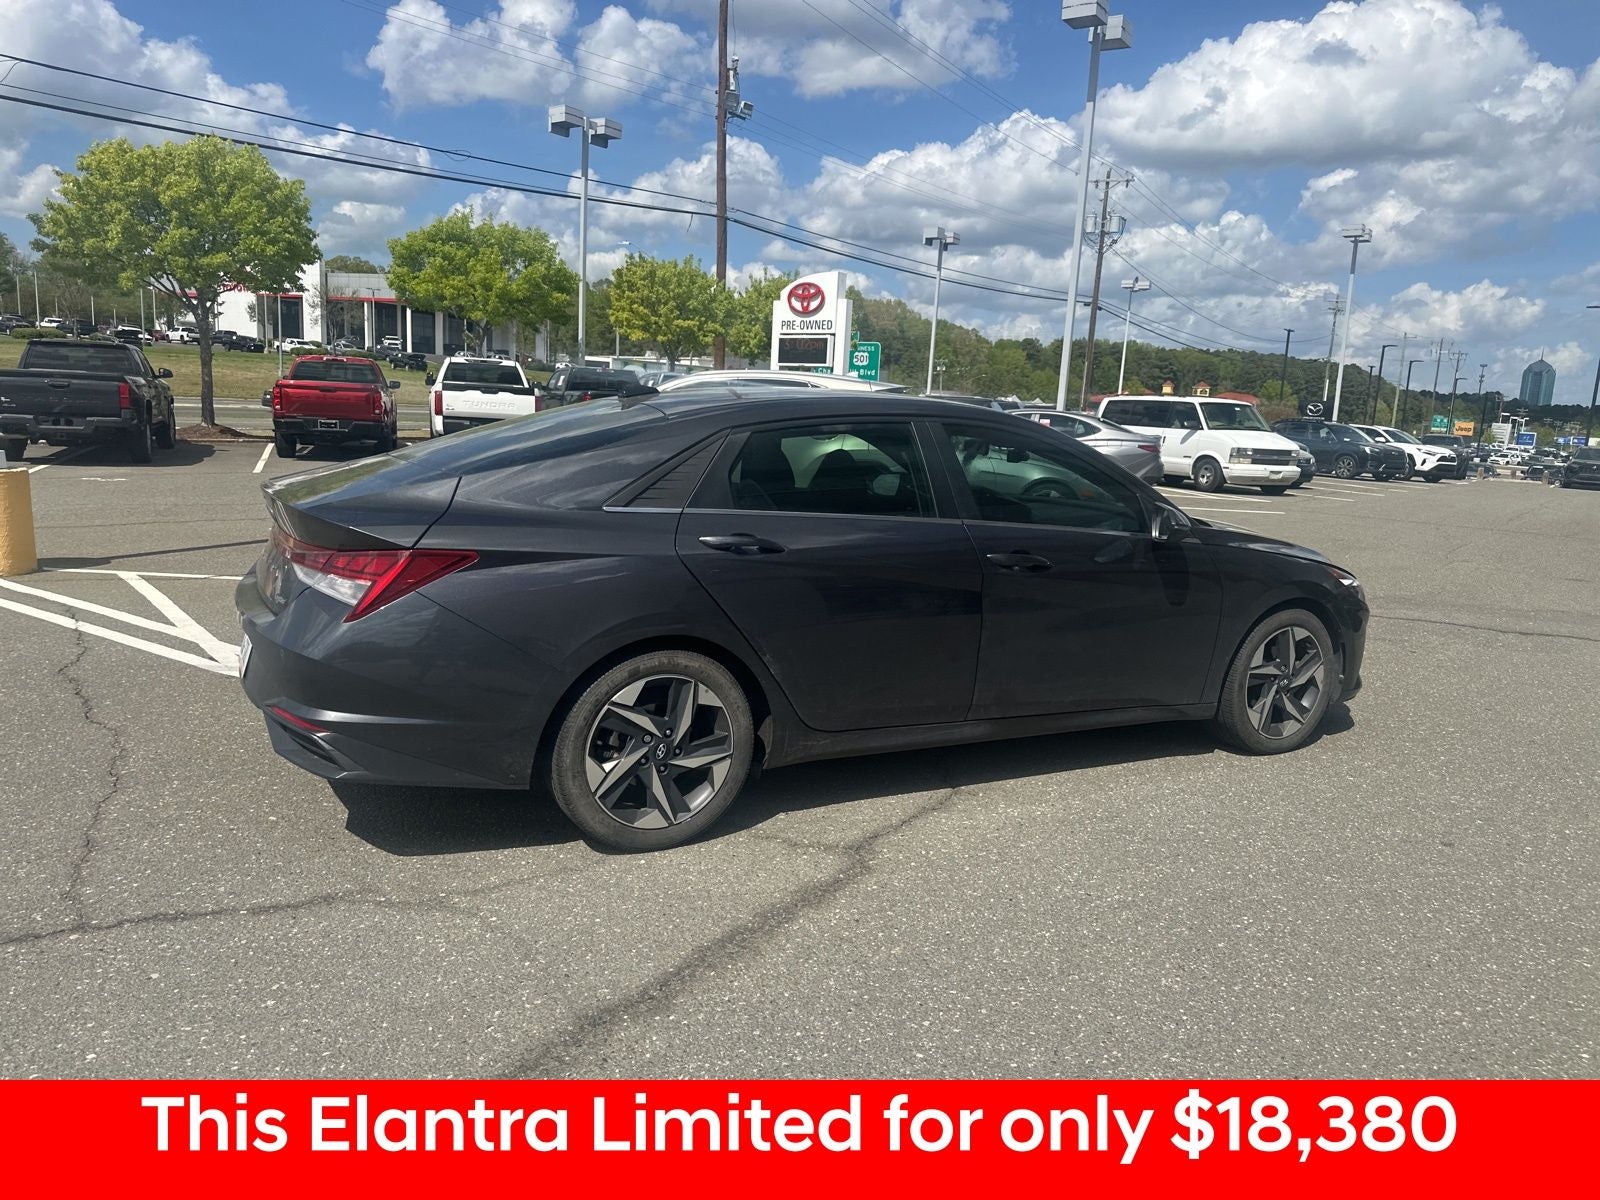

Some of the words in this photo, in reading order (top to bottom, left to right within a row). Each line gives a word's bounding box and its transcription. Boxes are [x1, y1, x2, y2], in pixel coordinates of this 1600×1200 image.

[781, 319, 833, 331] PRE-OWNED
[854, 354, 868, 364] 501
[859, 368, 876, 376] Blvd
[463, 399, 516, 409] TUNDRA
[1455, 425, 1472, 434] Jeep
